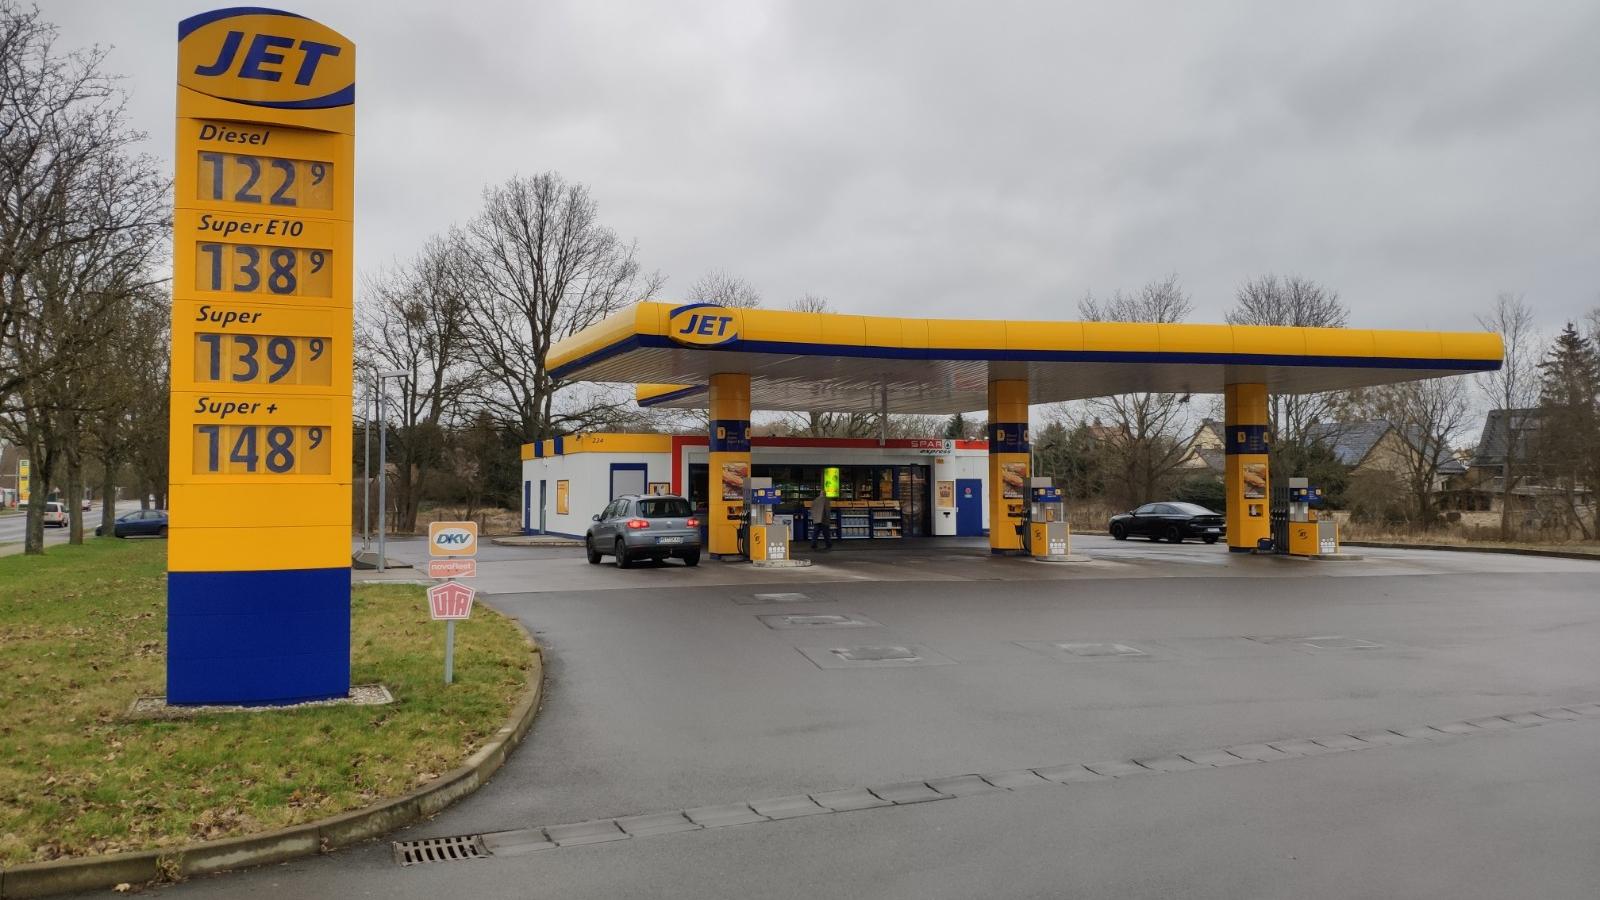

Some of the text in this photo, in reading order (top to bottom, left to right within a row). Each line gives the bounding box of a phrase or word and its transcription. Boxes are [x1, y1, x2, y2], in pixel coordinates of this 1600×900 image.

[194, 30, 341, 86] JET
[199, 124, 271, 146] Diesel
[198, 214, 304, 237] Super E10
[196, 305, 262, 328] Super
[680, 314, 733, 336] JET
[195, 397, 261, 419] Super
[911, 440, 943, 448] SPAR
[436, 533, 471, 544] DKV
